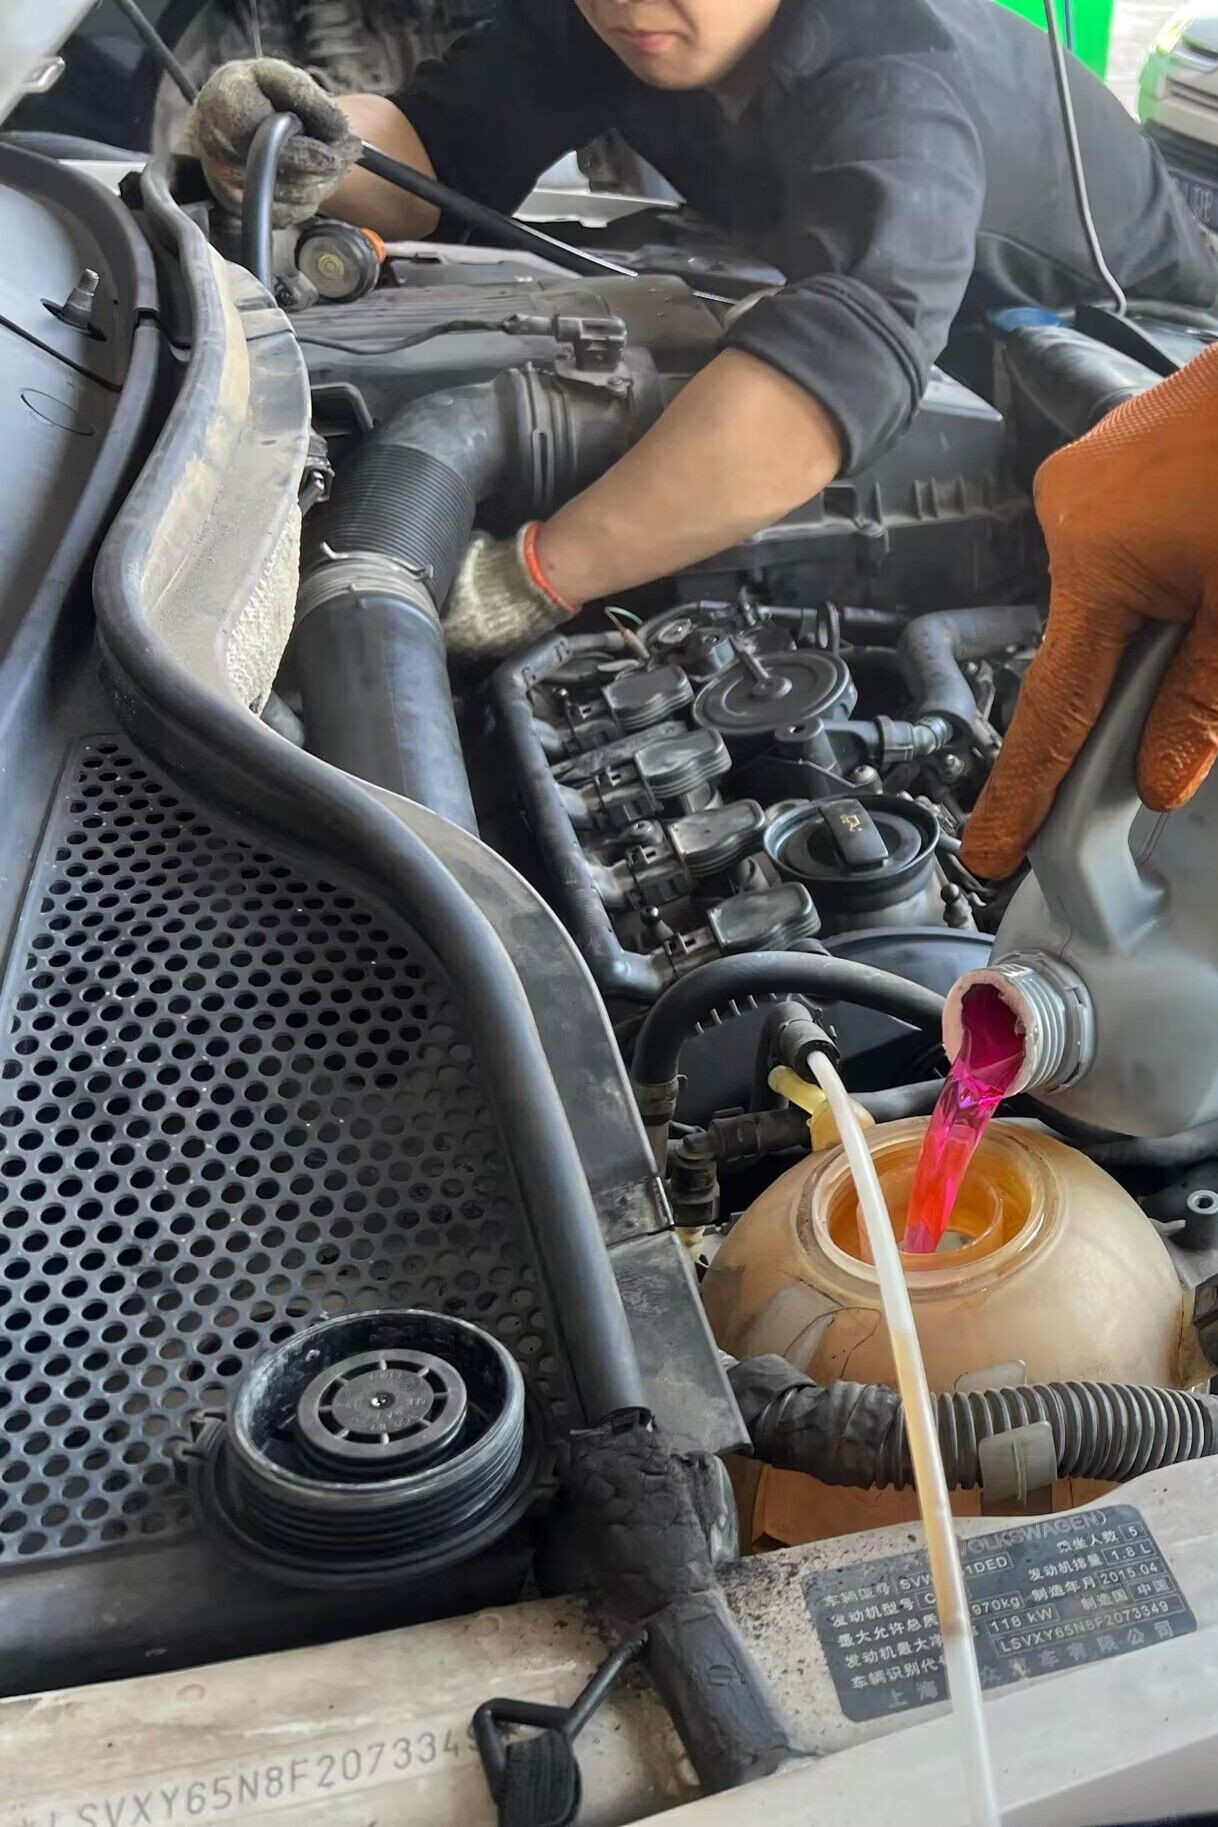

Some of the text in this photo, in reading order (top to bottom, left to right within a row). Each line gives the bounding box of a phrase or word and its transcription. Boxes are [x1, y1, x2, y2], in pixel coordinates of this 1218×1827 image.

[1129, 1526, 1138, 1538] 5
[1029, 1542, 1151, 1581] 发动机排量 1.8 L
[1031, 1564, 1158, 1601] 制造年月 2015.04
[1081, 1578, 1170, 1610] 制造国 中国
[832, 1597, 914, 1627] 发动机型号
[838, 1596, 1021, 1649] 最大允许总质 970kg
[991, 1614, 1022, 1633] 118
[1029, 1607, 1053, 1623] kW
[1000, 1599, 1170, 1654] LSVXY65N8F2073349
